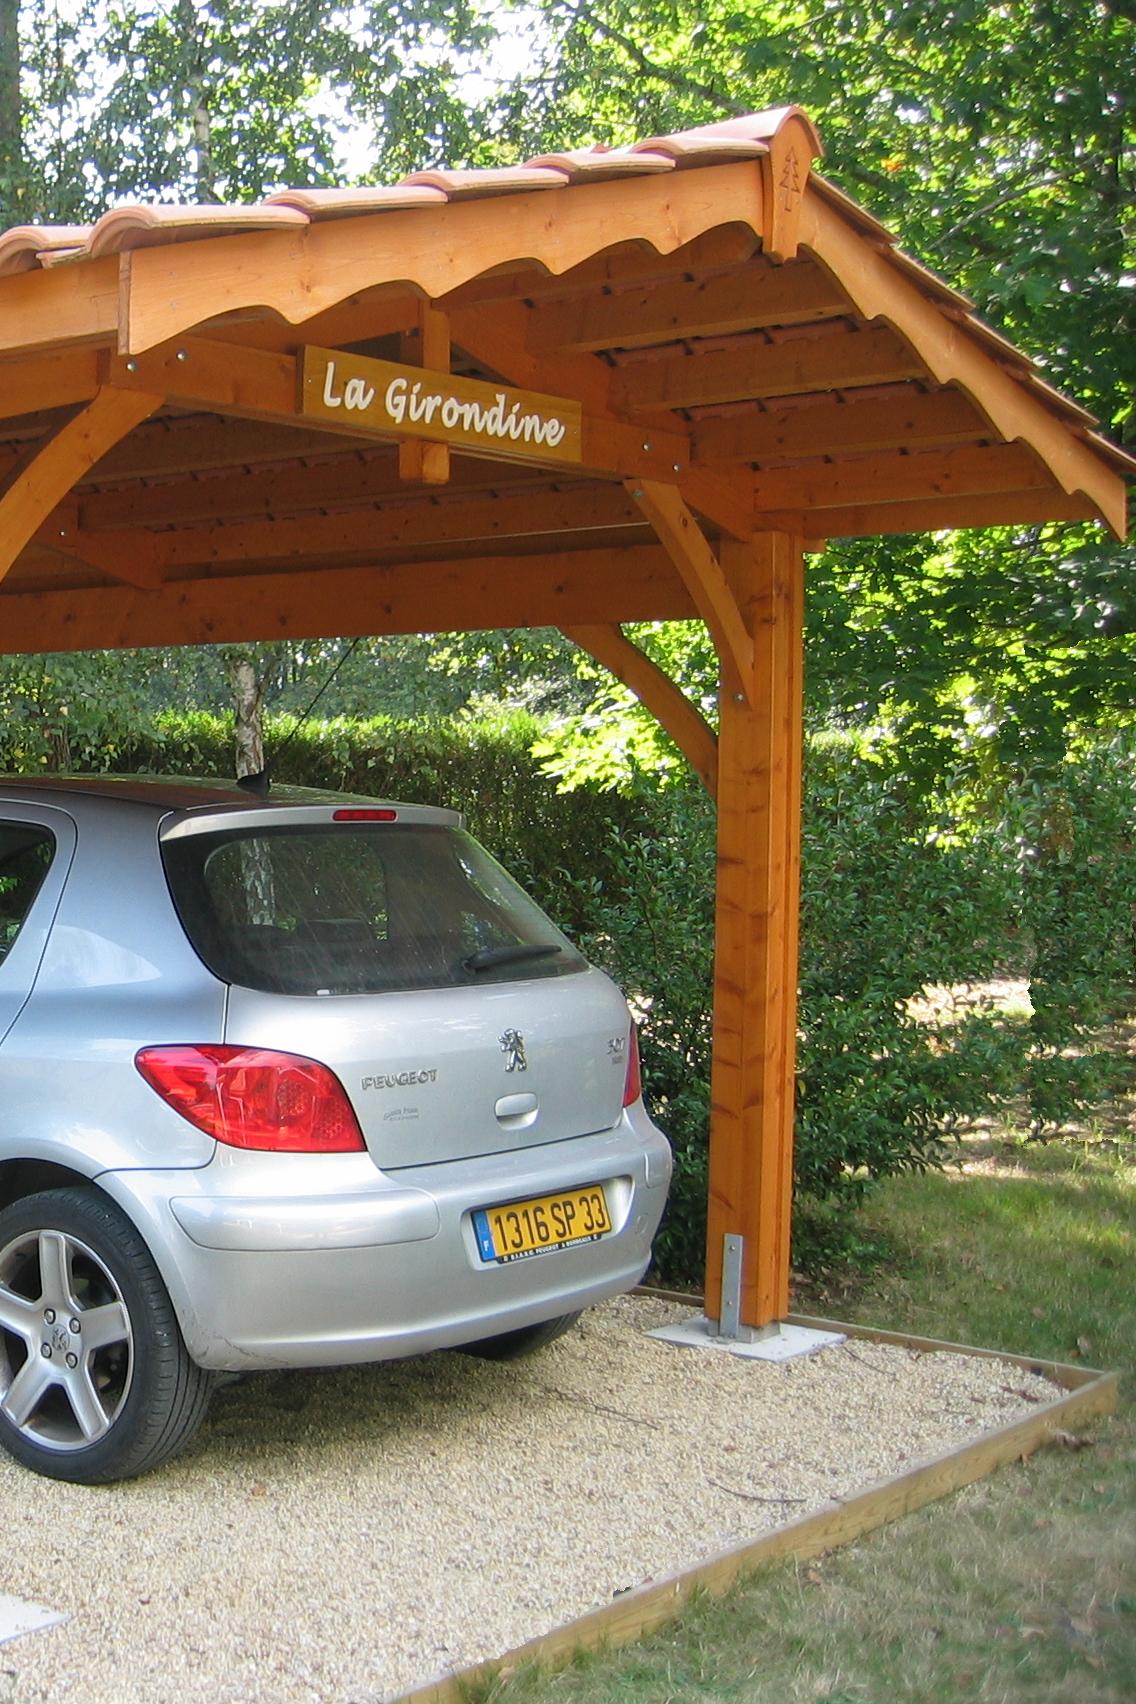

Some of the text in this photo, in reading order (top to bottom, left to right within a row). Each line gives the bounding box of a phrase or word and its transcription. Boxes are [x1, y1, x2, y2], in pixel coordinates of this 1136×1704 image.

[323, 361, 566, 448] La Girondine
[361, 1069, 437, 1090] PEUGEOT
[494, 1194, 606, 1251] 1316 SP 33
[483, 1240, 489, 1252] F
